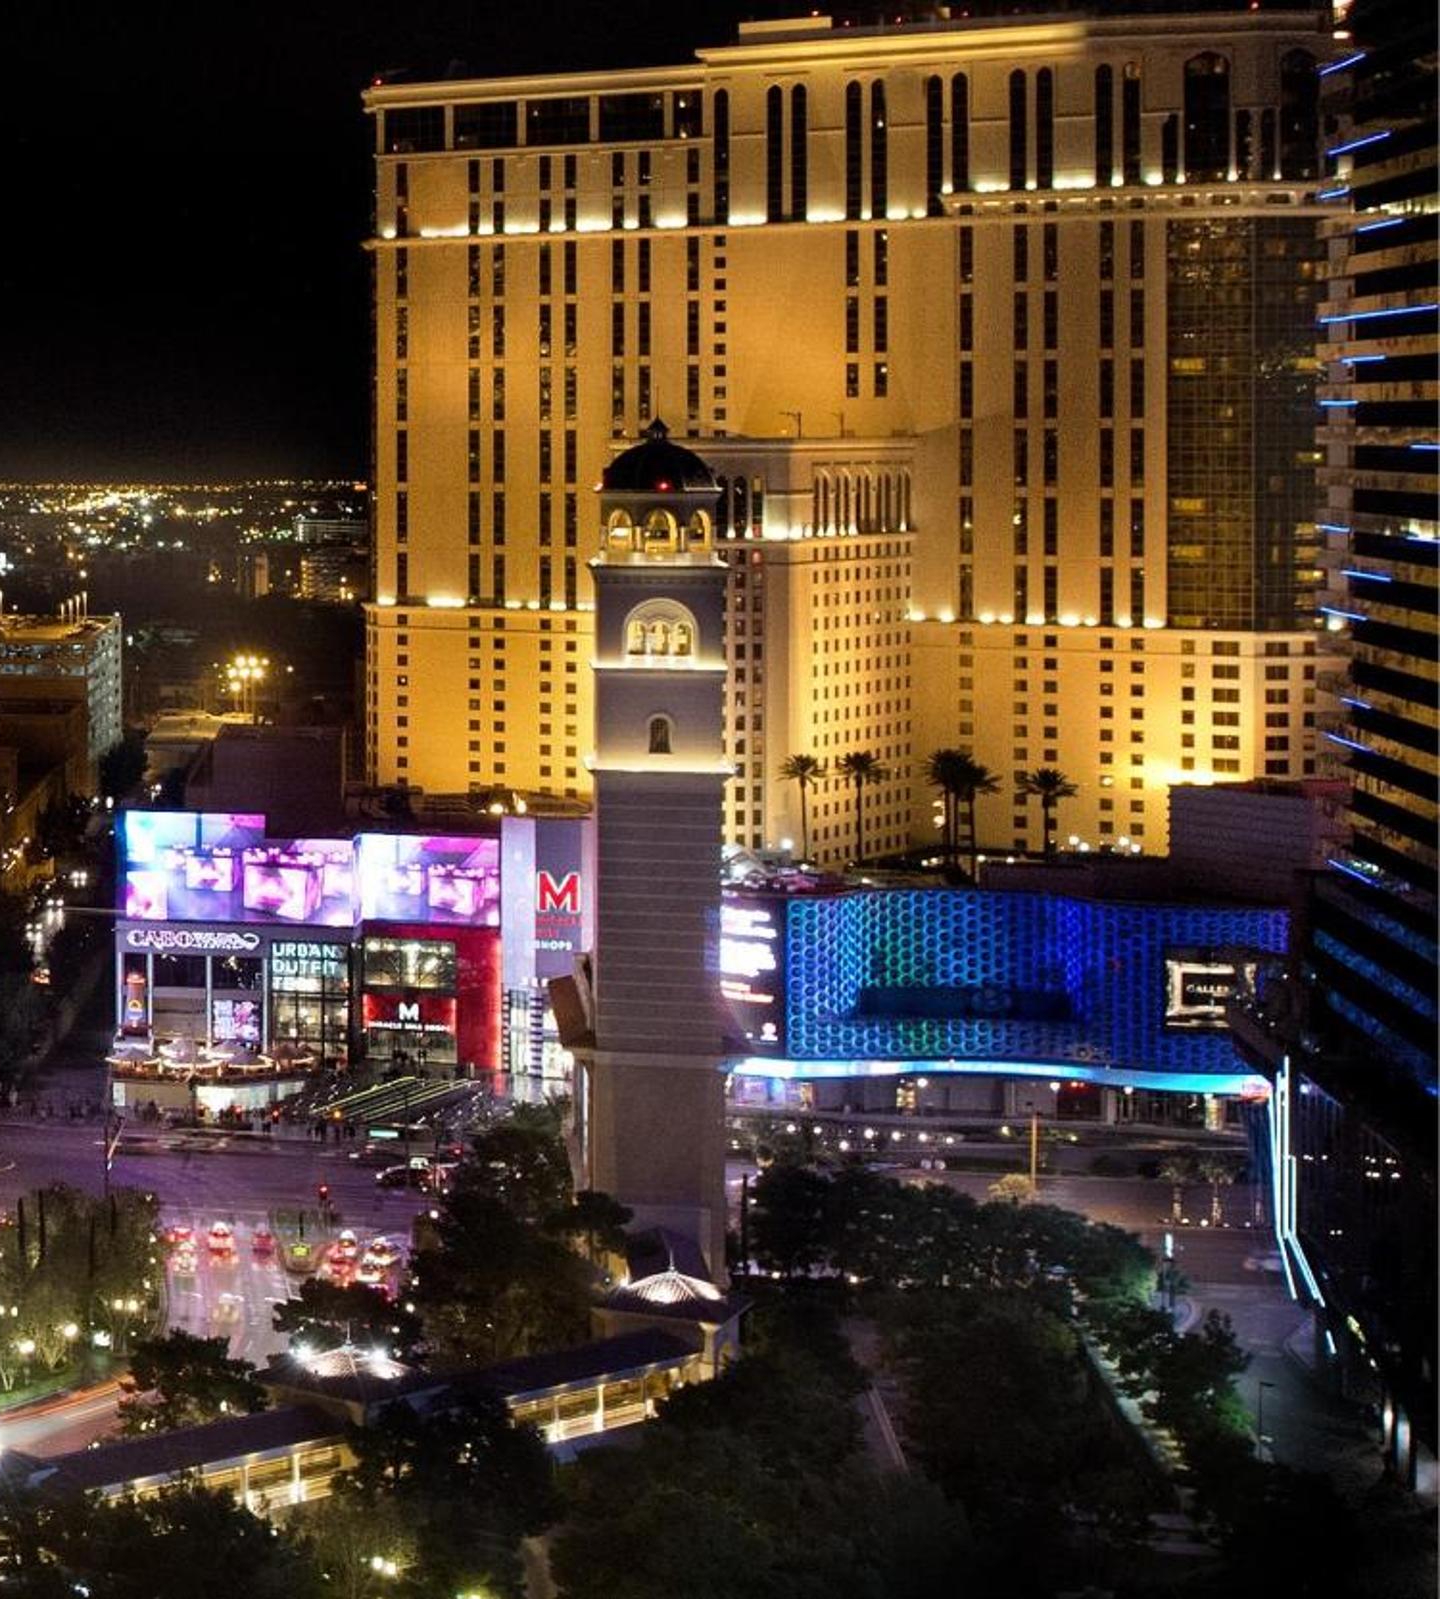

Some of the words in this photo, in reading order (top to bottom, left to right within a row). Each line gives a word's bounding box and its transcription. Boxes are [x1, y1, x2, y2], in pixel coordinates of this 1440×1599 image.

[537, 871, 581, 913] M
[272, 942, 337, 958] URBAN
[272, 959, 339, 975] OUTFIT
[398, 1002, 420, 1021] M
